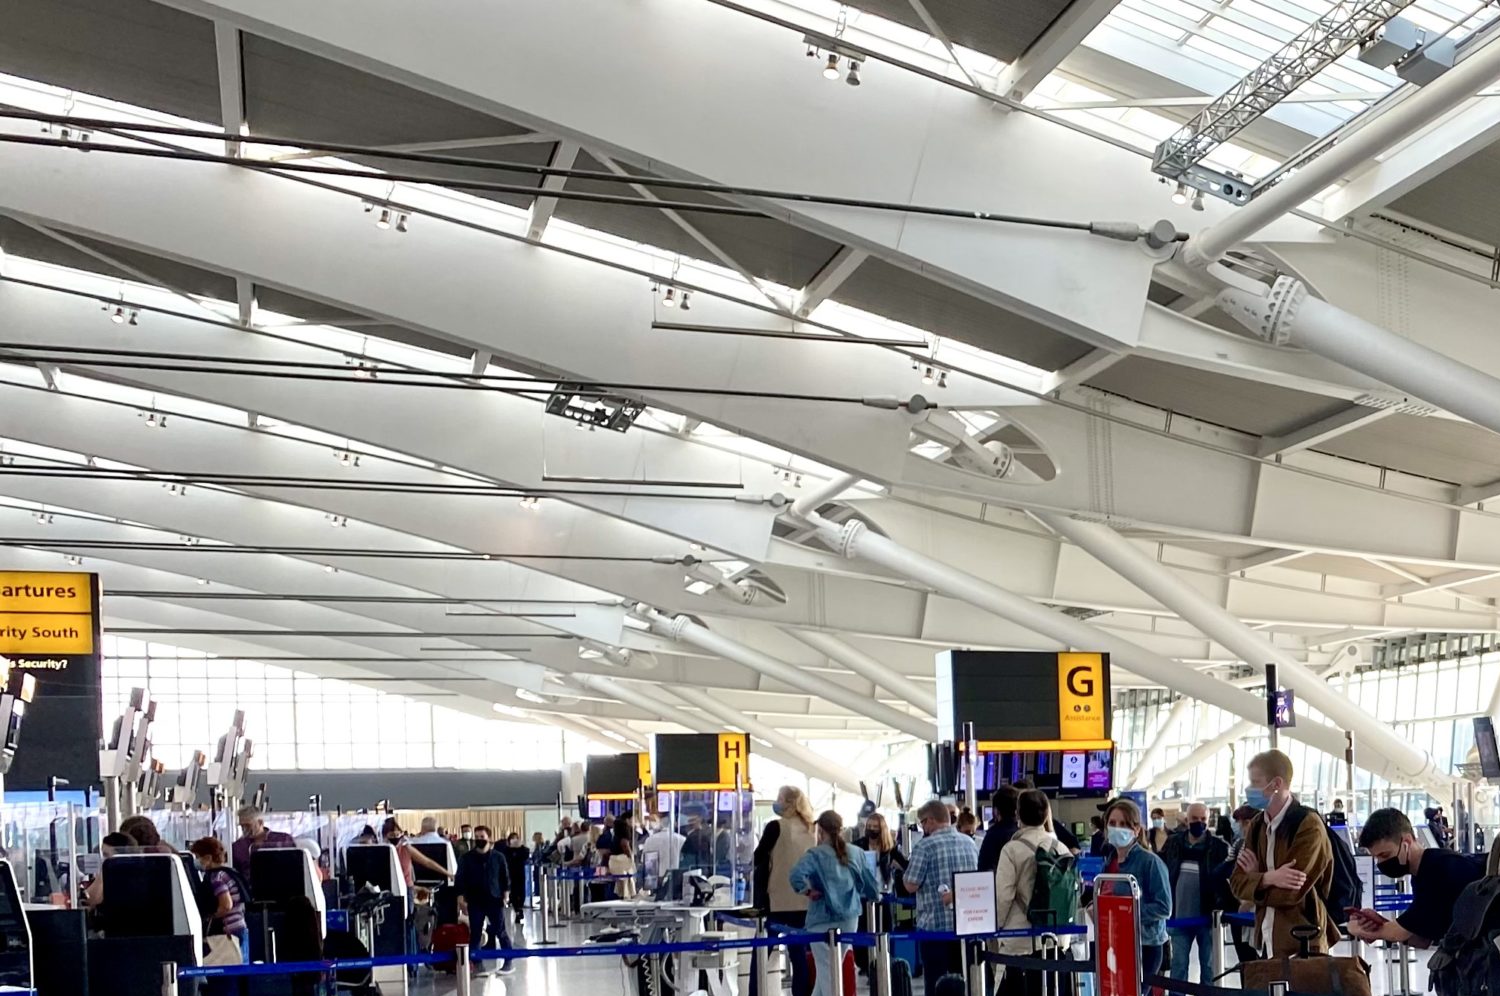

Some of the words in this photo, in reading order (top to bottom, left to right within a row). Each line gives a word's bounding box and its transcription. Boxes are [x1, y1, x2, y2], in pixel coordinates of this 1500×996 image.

[32, 626, 78, 639] South
[18, 659, 68, 670] Security?
[1066, 666, 1093, 697] G
[724, 741, 740, 758] H
